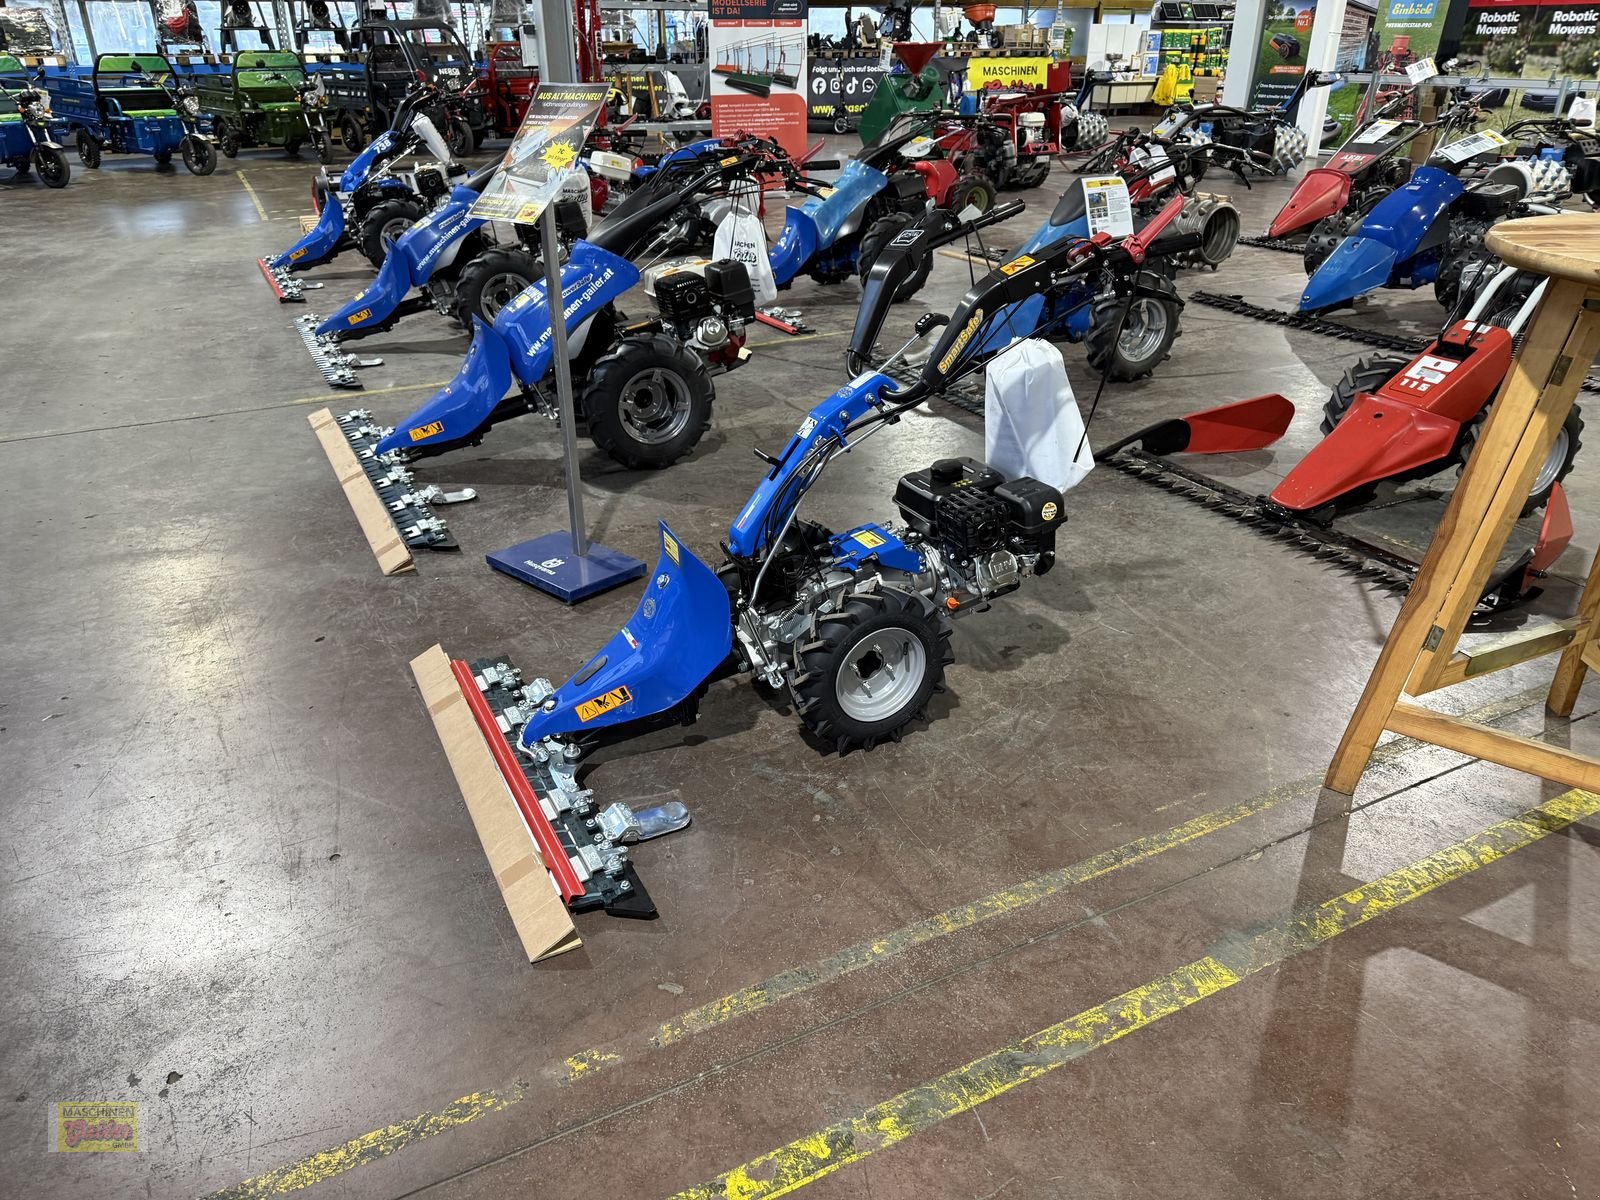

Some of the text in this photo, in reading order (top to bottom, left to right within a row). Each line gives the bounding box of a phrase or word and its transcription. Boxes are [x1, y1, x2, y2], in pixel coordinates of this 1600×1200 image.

[712, 7, 740, 15] IST DA!
[1392, 3, 1433, 15] Einböck
[1479, 11, 1520, 23] Robotic
[1552, 9, 1599, 22] Robotic
[1476, 24, 1518, 35] Mowers
[1548, 23, 1596, 35] Mowers
[812, 66, 828, 75] Folgt
[856, 65, 867, 73] auf
[982, 66, 1038, 76] MASCHINEN
[537, 92, 603, 101] AUS ALT MACH NEU!
[374, 141, 392, 154] 738
[703, 143, 720, 152] 738
[938, 315, 981, 373] SmartSafe
[1400, 378, 1431, 392] 115
